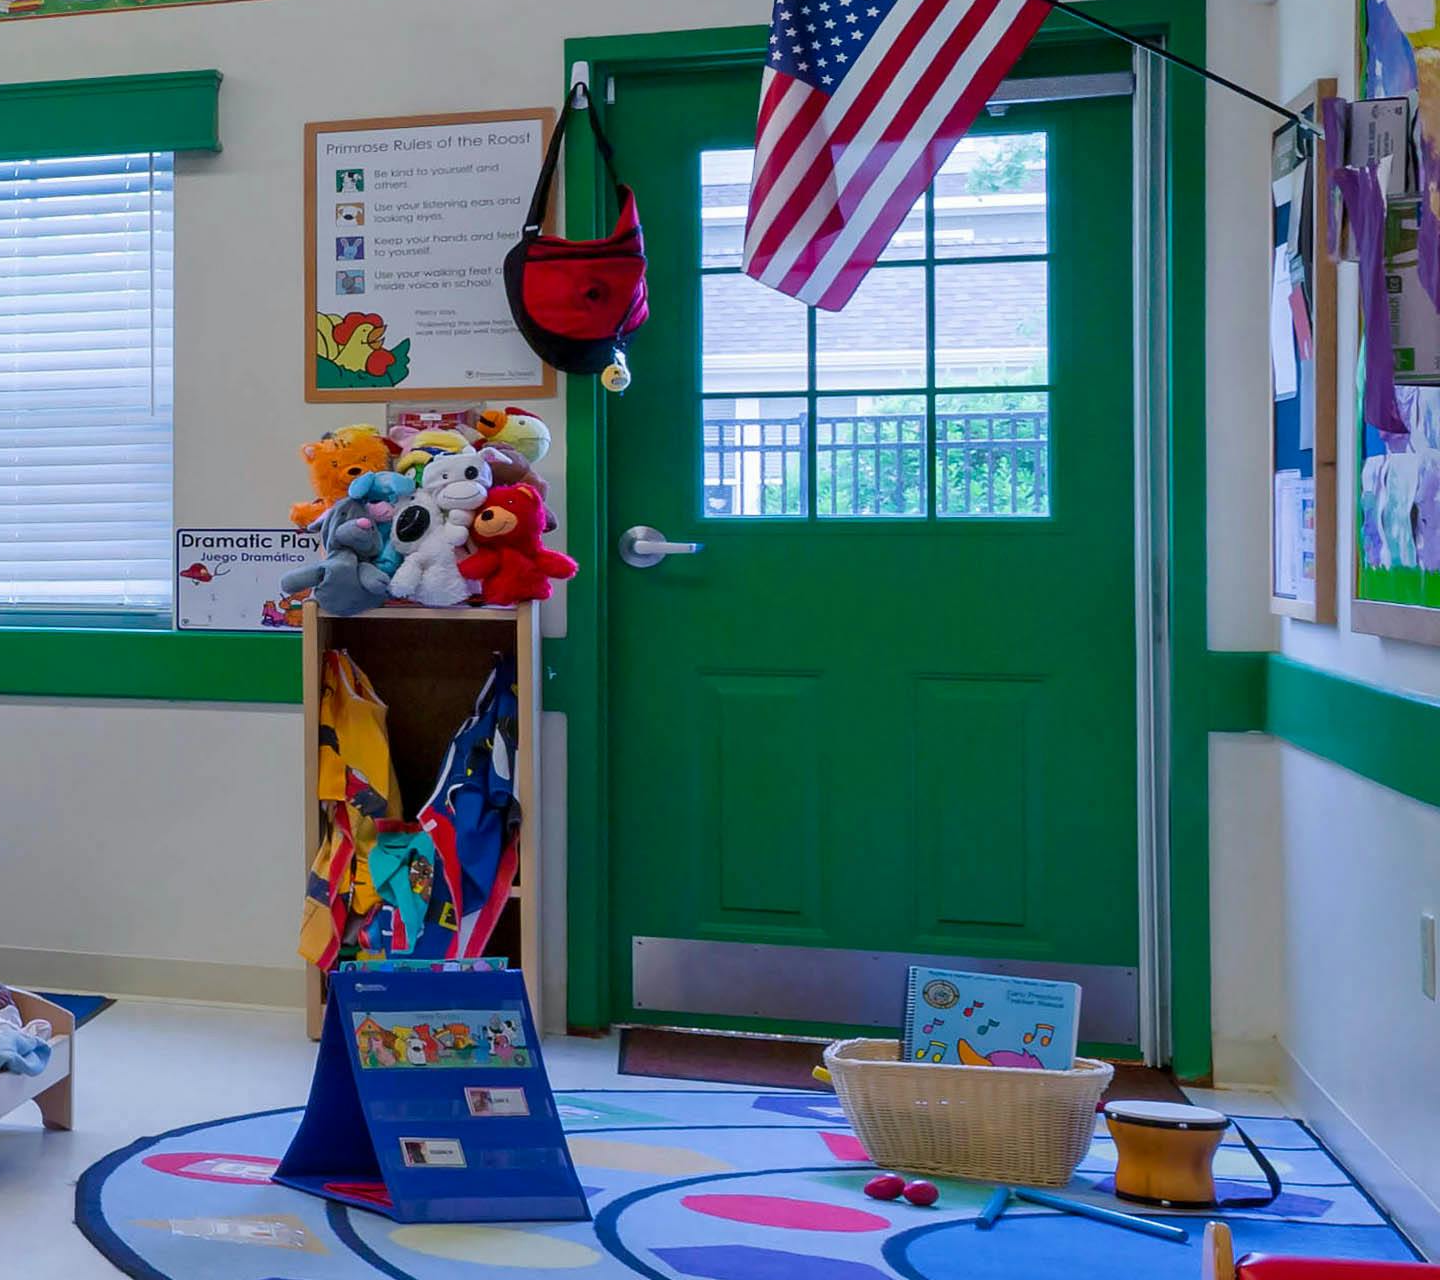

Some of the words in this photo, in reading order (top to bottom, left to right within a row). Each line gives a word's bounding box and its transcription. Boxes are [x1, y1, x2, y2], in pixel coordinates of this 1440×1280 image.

[326, 139, 389, 155] Primrose
[393, 137, 432, 152] Rules
[436, 135, 453, 150] of
[457, 134, 483, 147] the
[487, 132, 531, 145] Roost
[374, 169, 388, 178] Be
[391, 169, 413, 177] kind
[416, 167, 428, 176] to
[476, 163, 500, 172] and
[374, 202, 393, 212] Use
[396, 202, 420, 212] your
[498, 196, 521, 206] and
[374, 236, 403, 247] Keep
[406, 235, 430, 246] your
[432, 233, 468, 243] hands
[470, 231, 494, 241] and
[496, 230, 520, 240] feet
[374, 247, 386, 257] to
[374, 270, 394, 280] Use
[396, 270, 421, 280] your
[424, 267, 467, 279] walking
[468, 266, 493, 276] feet
[408, 280, 440, 290] voice
[441, 280, 453, 289] in
[181, 533, 273, 548] Dramatic
[280, 533, 320, 552] Play
[200, 552, 238, 563] Juego
[241, 551, 305, 562] Dramático
